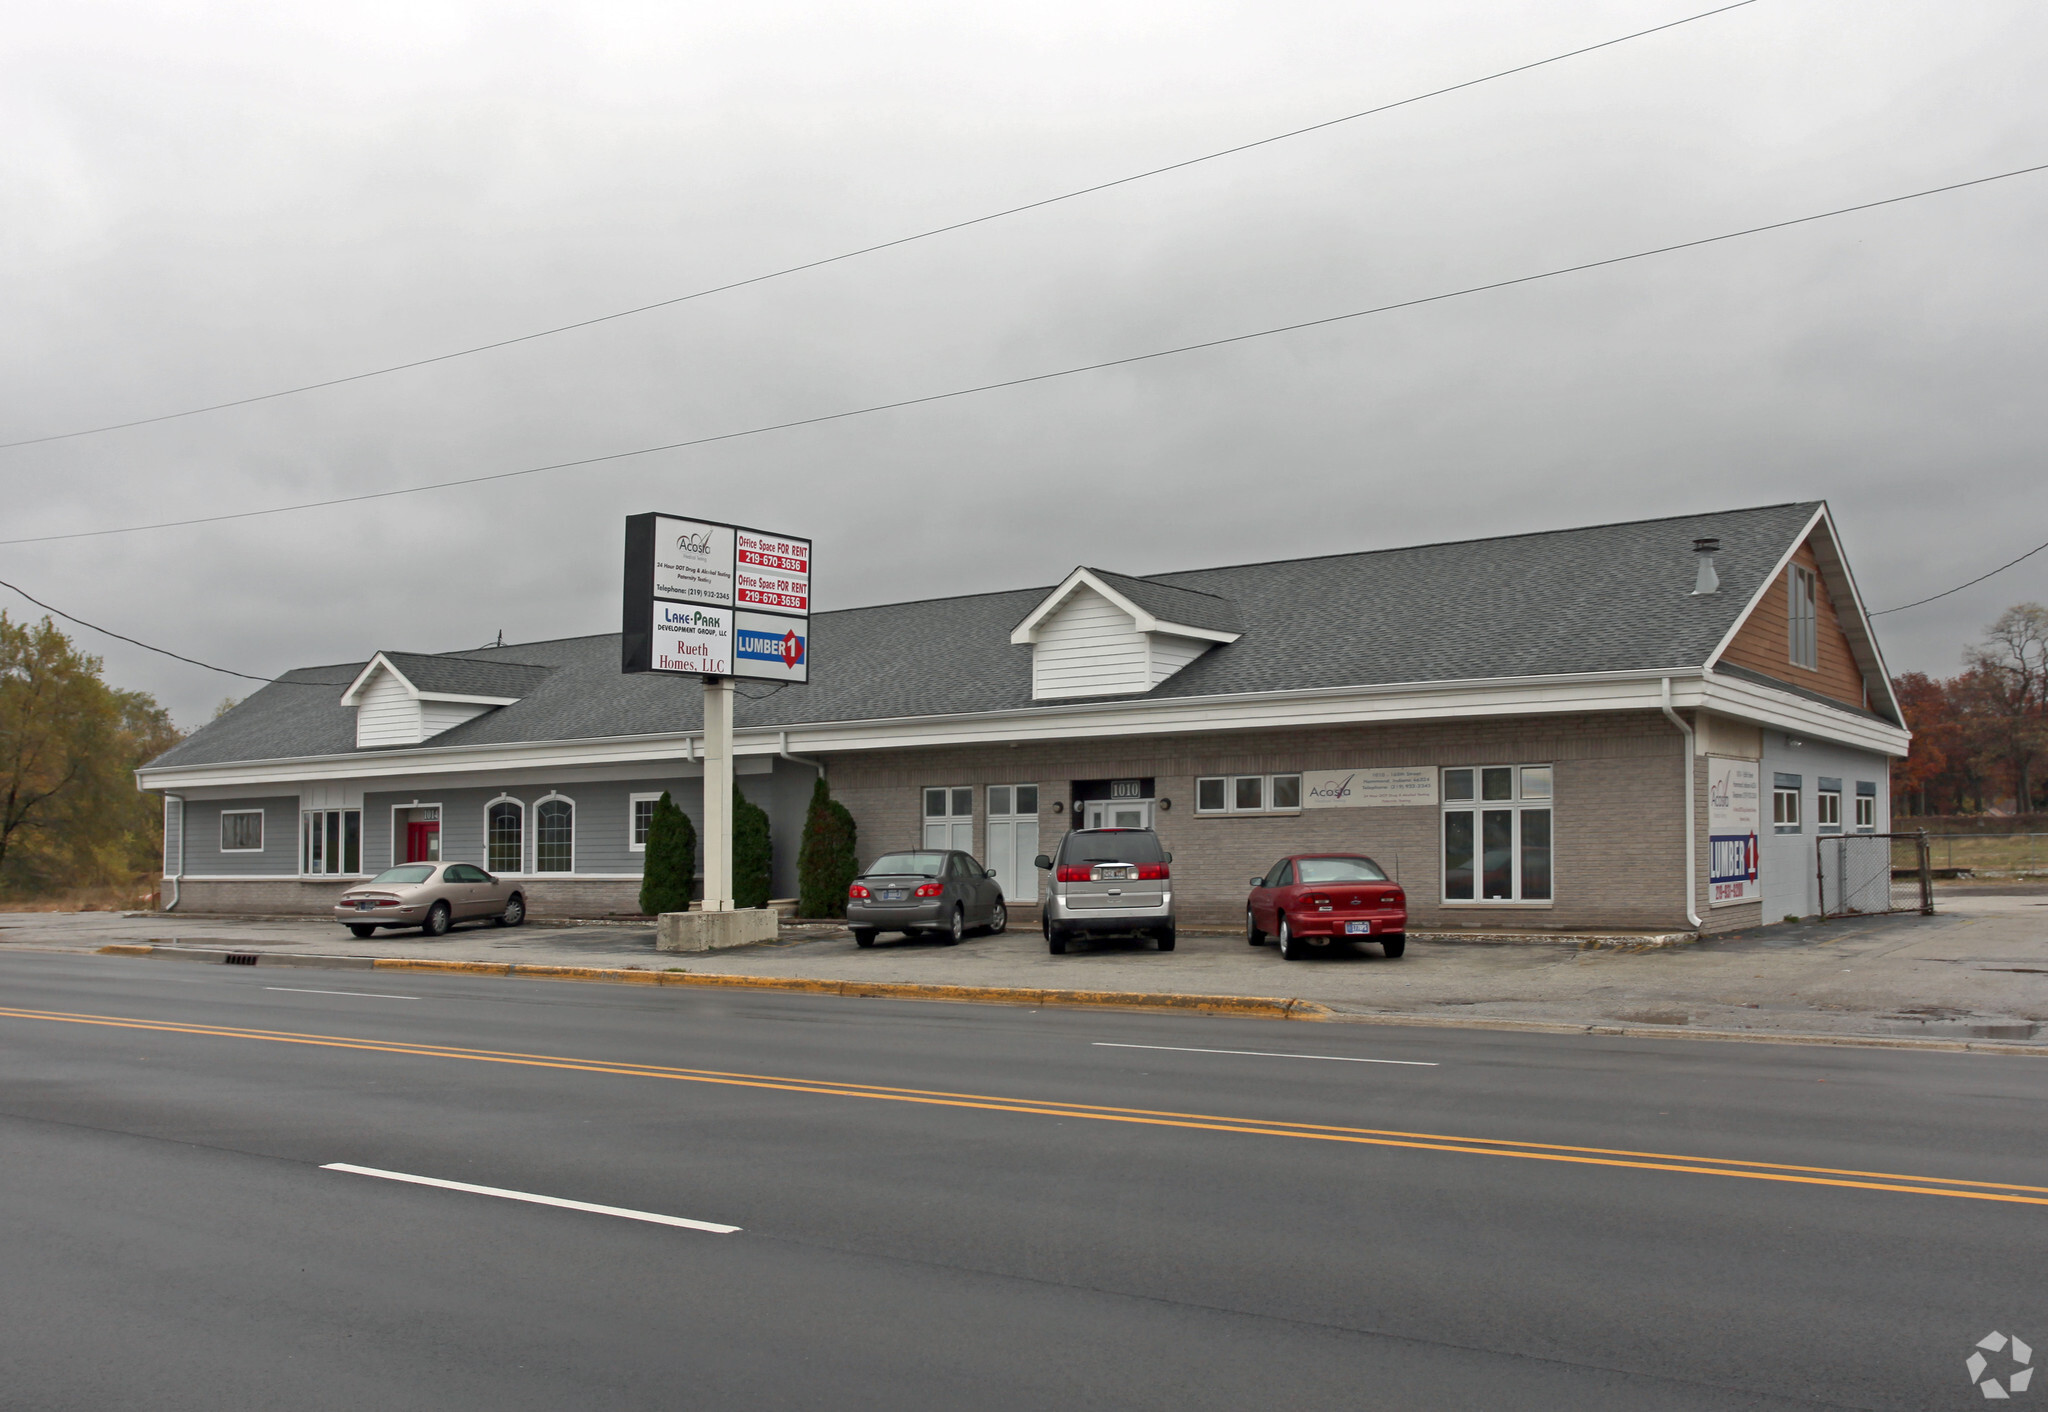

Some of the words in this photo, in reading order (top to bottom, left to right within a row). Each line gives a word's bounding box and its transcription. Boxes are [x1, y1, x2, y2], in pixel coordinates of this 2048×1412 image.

[679, 537, 711, 554] Acosta
[739, 535, 757, 549] Office
[758, 539, 776, 552] Space
[777, 542, 790, 554] FOR
[792, 545, 808, 557] RENT
[745, 552, 801, 570] 219-670-3636
[677, 573, 697, 582] Paternity
[686, 566, 696, 574] Drug
[717, 571, 731, 579] Testing
[657, 584, 687, 594] Telephone:
[688, 588, 702, 597] (219)
[738, 574, 757, 587] Office
[758, 577, 775, 590] Space
[777, 580, 789, 592] FOR
[791, 583, 807, 594] RENT
[745, 591, 801, 607] 219-670-3636
[657, 624, 696, 633] DEVELOPMENT
[697, 627, 717, 637] GROUP,
[677, 640, 708, 656] Rueth
[738, 636, 786, 656] LUMBER
[787, 637, 796, 657] 1
[702, 658, 725, 673] LLC
[1113, 783, 1139, 797] 1010
[1309, 786, 1351, 799] Acosta
[424, 809, 438, 820] 1014
[1710, 840, 1745, 878] LUMBER
[1747, 838, 1756, 873] 1
